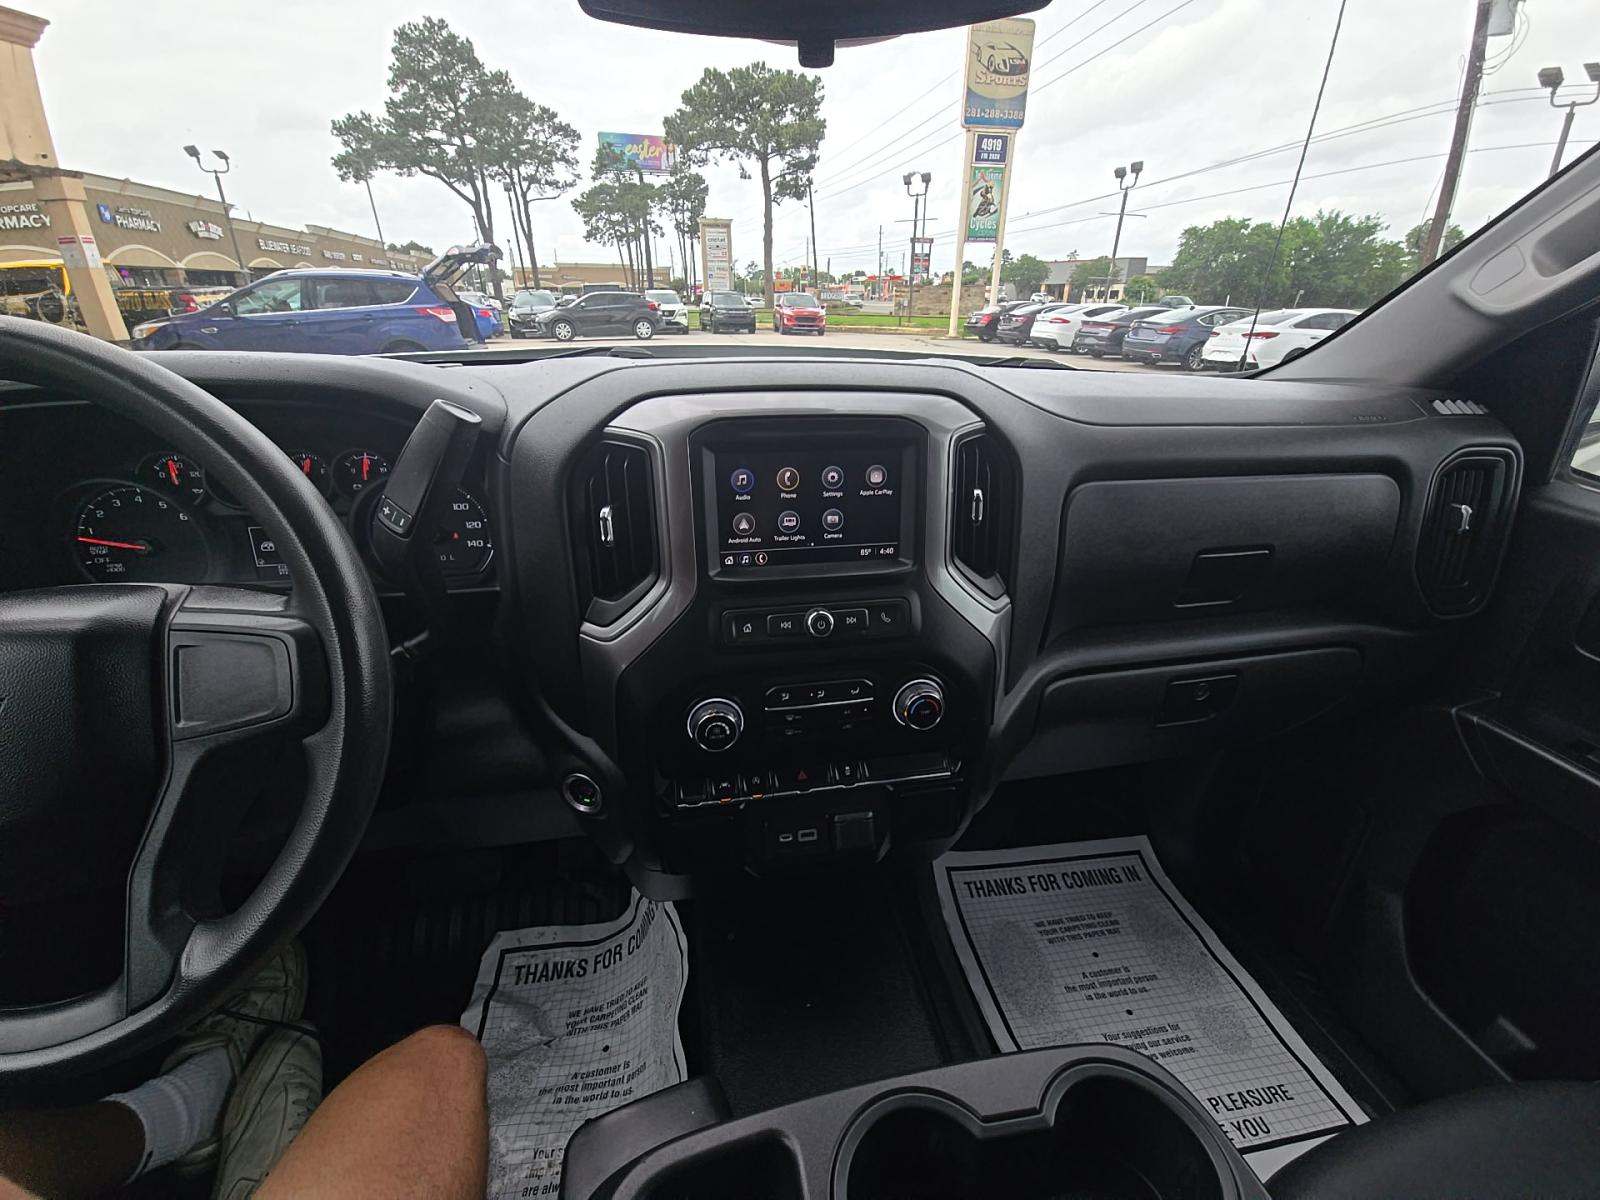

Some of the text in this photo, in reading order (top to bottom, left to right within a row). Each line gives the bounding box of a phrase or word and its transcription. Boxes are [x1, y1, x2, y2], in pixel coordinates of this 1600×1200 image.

[981, 138, 1002, 151] 4919
[0, 203, 38, 213] OPCARE
[0, 214, 50, 229] RMACY
[115, 215, 161, 233] PHARMACY
[970, 218, 997, 230] Cycles
[135, 495, 142, 503] 4
[860, 489, 874, 497] Apple
[158, 501, 168, 509] 5
[95, 510, 104, 518] 2
[466, 521, 482, 529] 120
[964, 865, 1142, 898] THANKS FOR COMING IN
[514, 958, 588, 985] THANKS
[593, 943, 623, 974] FOR
[1082, 971, 1088, 979] A
[1064, 974, 1158, 993] the most important person
[628, 987, 648, 1006] CLEAN
[1094, 991, 1107, 1000] the
[1107, 988, 1129, 998] world
[1128, 987, 1138, 995] to
[568, 1009, 581, 1019] WE
[583, 1003, 605, 1015] HAVE
[1101, 1022, 1181, 1042] Your suggestions for
[1147, 1039, 1161, 1048] our
[1162, 1034, 1191, 1045] service
[571, 1060, 631, 1080] A customer is
[555, 1083, 579, 1096] most
[581, 1075, 625, 1092] important
[564, 1095, 579, 1104] the
[582, 1090, 608, 1103] world
[611, 1089, 620, 1098] to
[1207, 1084, 1294, 1114] PLEASURE
[1230, 1116, 1271, 1139] YOU
[533, 1147, 556, 1160] Your
[522, 1182, 560, 1197] are alw
